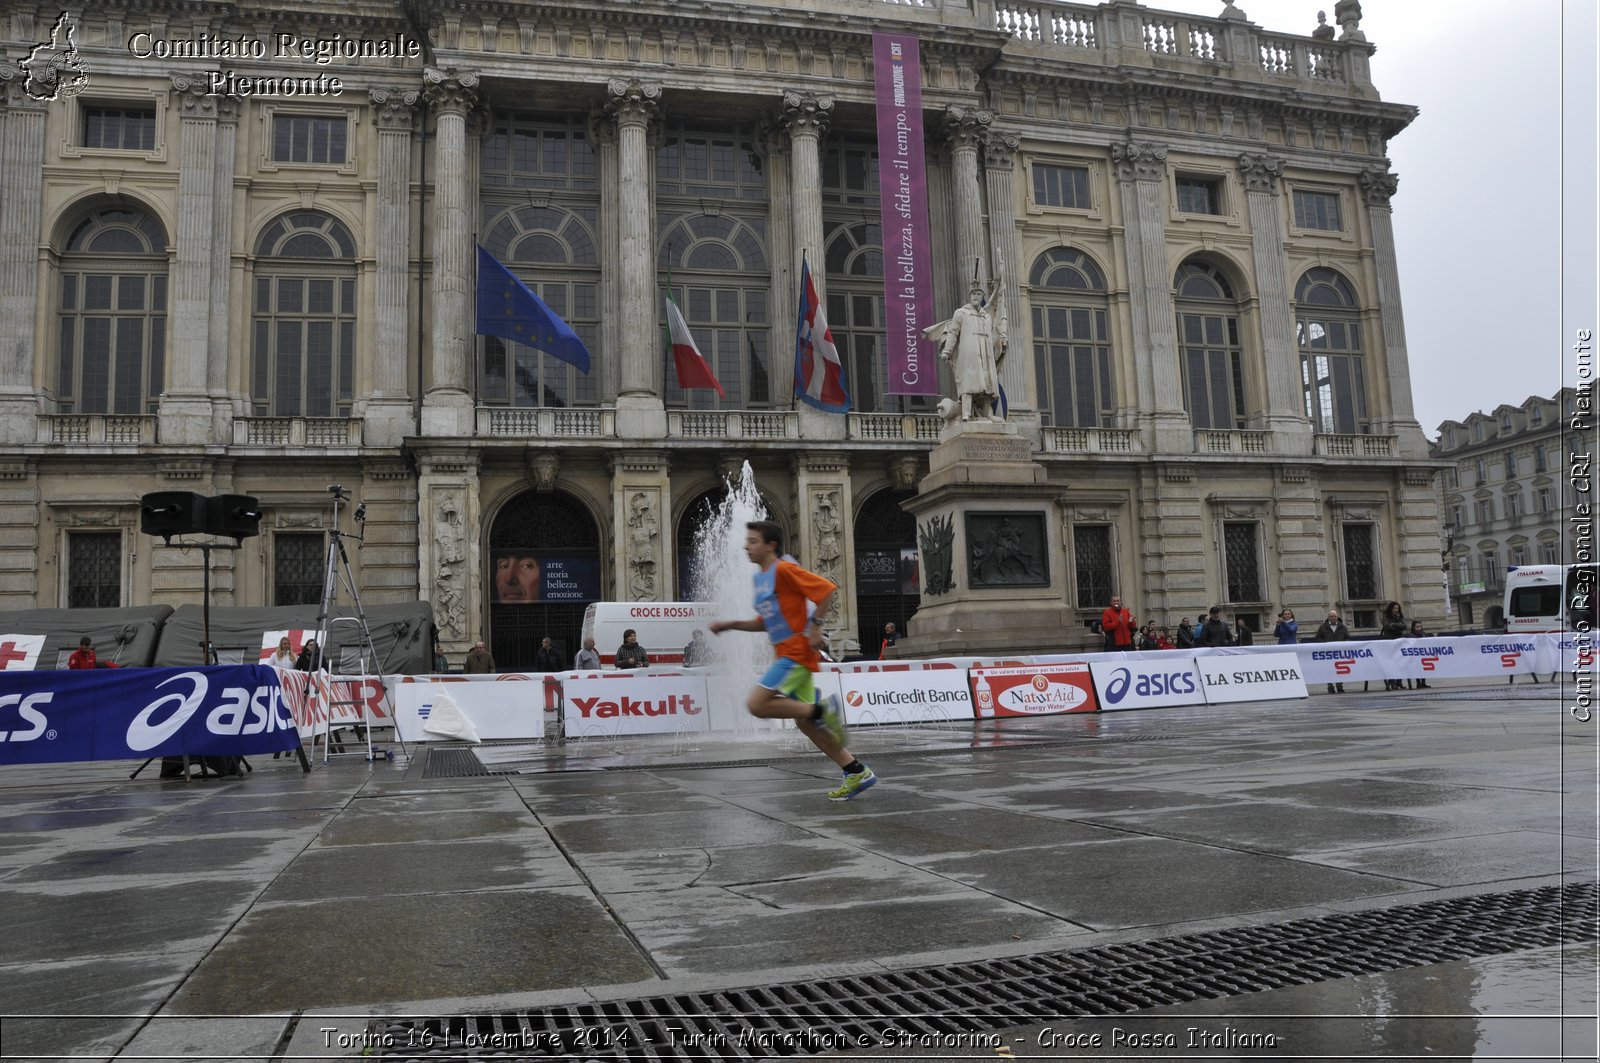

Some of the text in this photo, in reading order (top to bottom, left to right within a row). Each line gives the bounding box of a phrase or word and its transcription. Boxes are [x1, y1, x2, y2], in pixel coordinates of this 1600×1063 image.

[892, 64, 906, 107] FONDAZIONE
[893, 110, 919, 385] Conservare la bellezza, sfidare il tempo.
[859, 557, 896, 566] WOMEN
[546, 570, 569, 578] storia
[547, 580, 578, 589] bellezza
[547, 590, 584, 598] emozione
[630, 607, 661, 618] CROCE
[663, 607, 695, 618] ROSSA
[1400, 646, 1454, 657] ESSELUNGA
[1480, 643, 1536, 654] ESSELUNGA
[1312, 648, 1374, 661] ESSELUNGA
[1205, 668, 1300, 686] LA STAMPA
[867, 689, 968, 705] UniCredit Banca
[570, 694, 702, 718] Yakult
